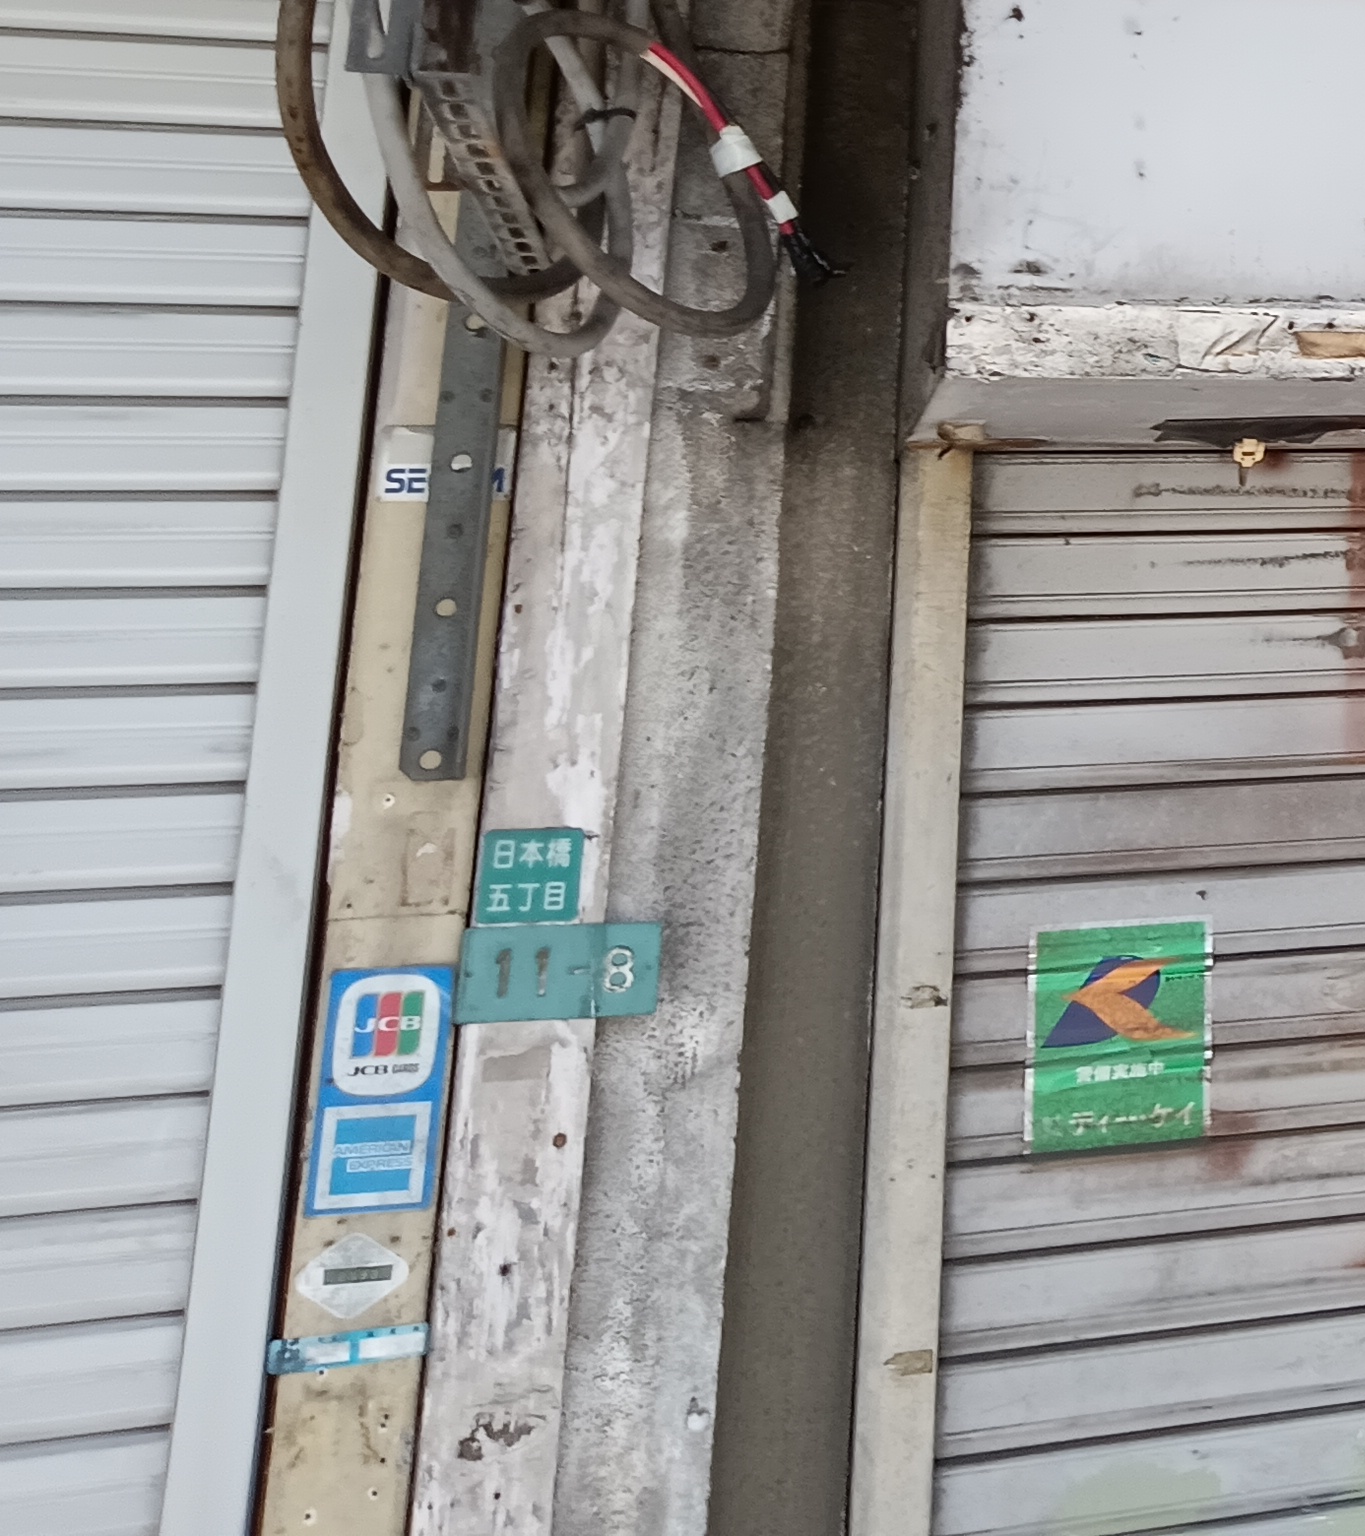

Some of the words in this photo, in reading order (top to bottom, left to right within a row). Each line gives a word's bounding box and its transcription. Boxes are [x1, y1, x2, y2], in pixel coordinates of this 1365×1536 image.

[384, 467, 505, 494] SEM
[492, 837, 572, 869] 日本橋
[486, 881, 566, 912] 五丁目
[353, 1015, 422, 1033] JCB
[347, 1064, 389, 1076] JCB
[333, 1140, 411, 1156] AMERICAN
[348, 1157, 413, 1172] EXPRESS
